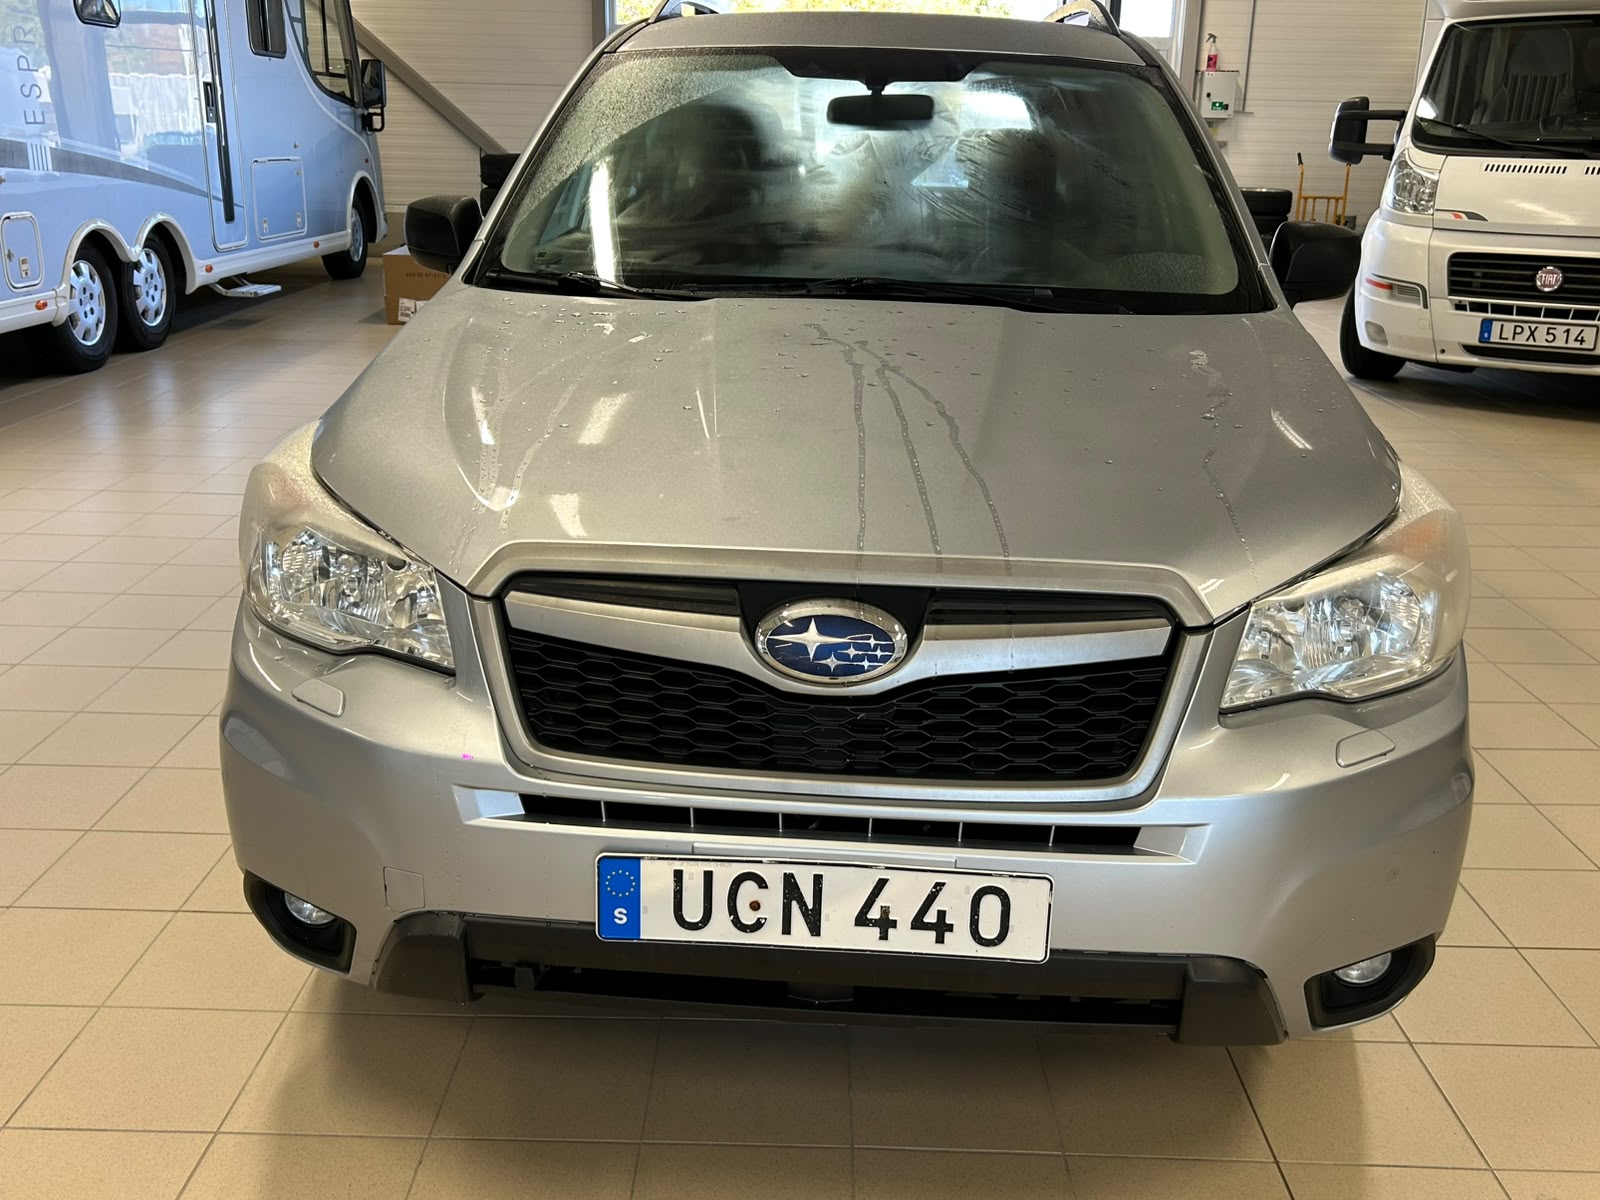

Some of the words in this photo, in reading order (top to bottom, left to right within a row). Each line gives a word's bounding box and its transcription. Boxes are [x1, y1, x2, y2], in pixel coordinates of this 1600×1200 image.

[1541, 273, 1558, 285] FIAT
[1499, 324, 1539, 342] LPX
[1545, 327, 1586, 346] 514
[613, 907, 628, 925] S
[672, 868, 824, 937] UCN
[854, 877, 1012, 947] 440
